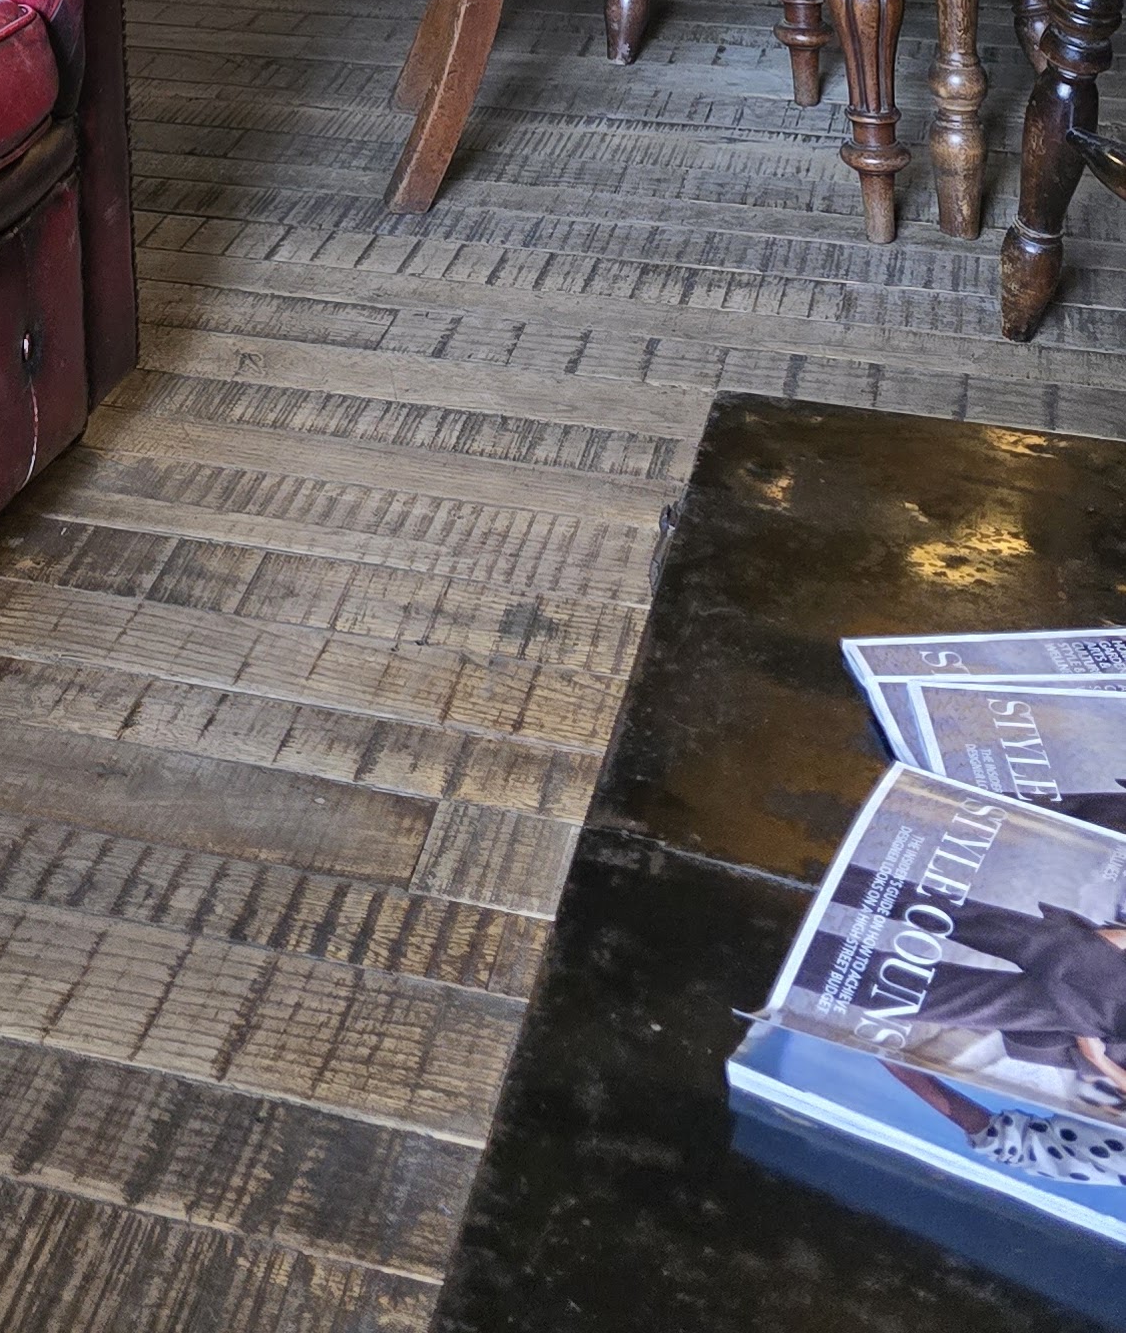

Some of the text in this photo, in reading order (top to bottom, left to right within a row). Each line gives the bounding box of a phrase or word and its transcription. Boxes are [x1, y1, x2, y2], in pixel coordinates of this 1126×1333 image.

[1057, 642, 1082, 666] STYLE
[1072, 642, 1103, 673] CULTUR
[1083, 641, 1108, 661] ARTS
[965, 743, 986, 779] DESIGNER
[980, 748, 994, 763] THE
[987, 699, 1062, 801] STYLE
[916, 797, 1007, 907] STYLE
[816, 825, 913, 1015] DESIGNER LOOKS ON A HIGH STREET BUDGET
[833, 834, 925, 1015] THE INSIDER'S GUIDE ON HOW TO ACHIEVE
